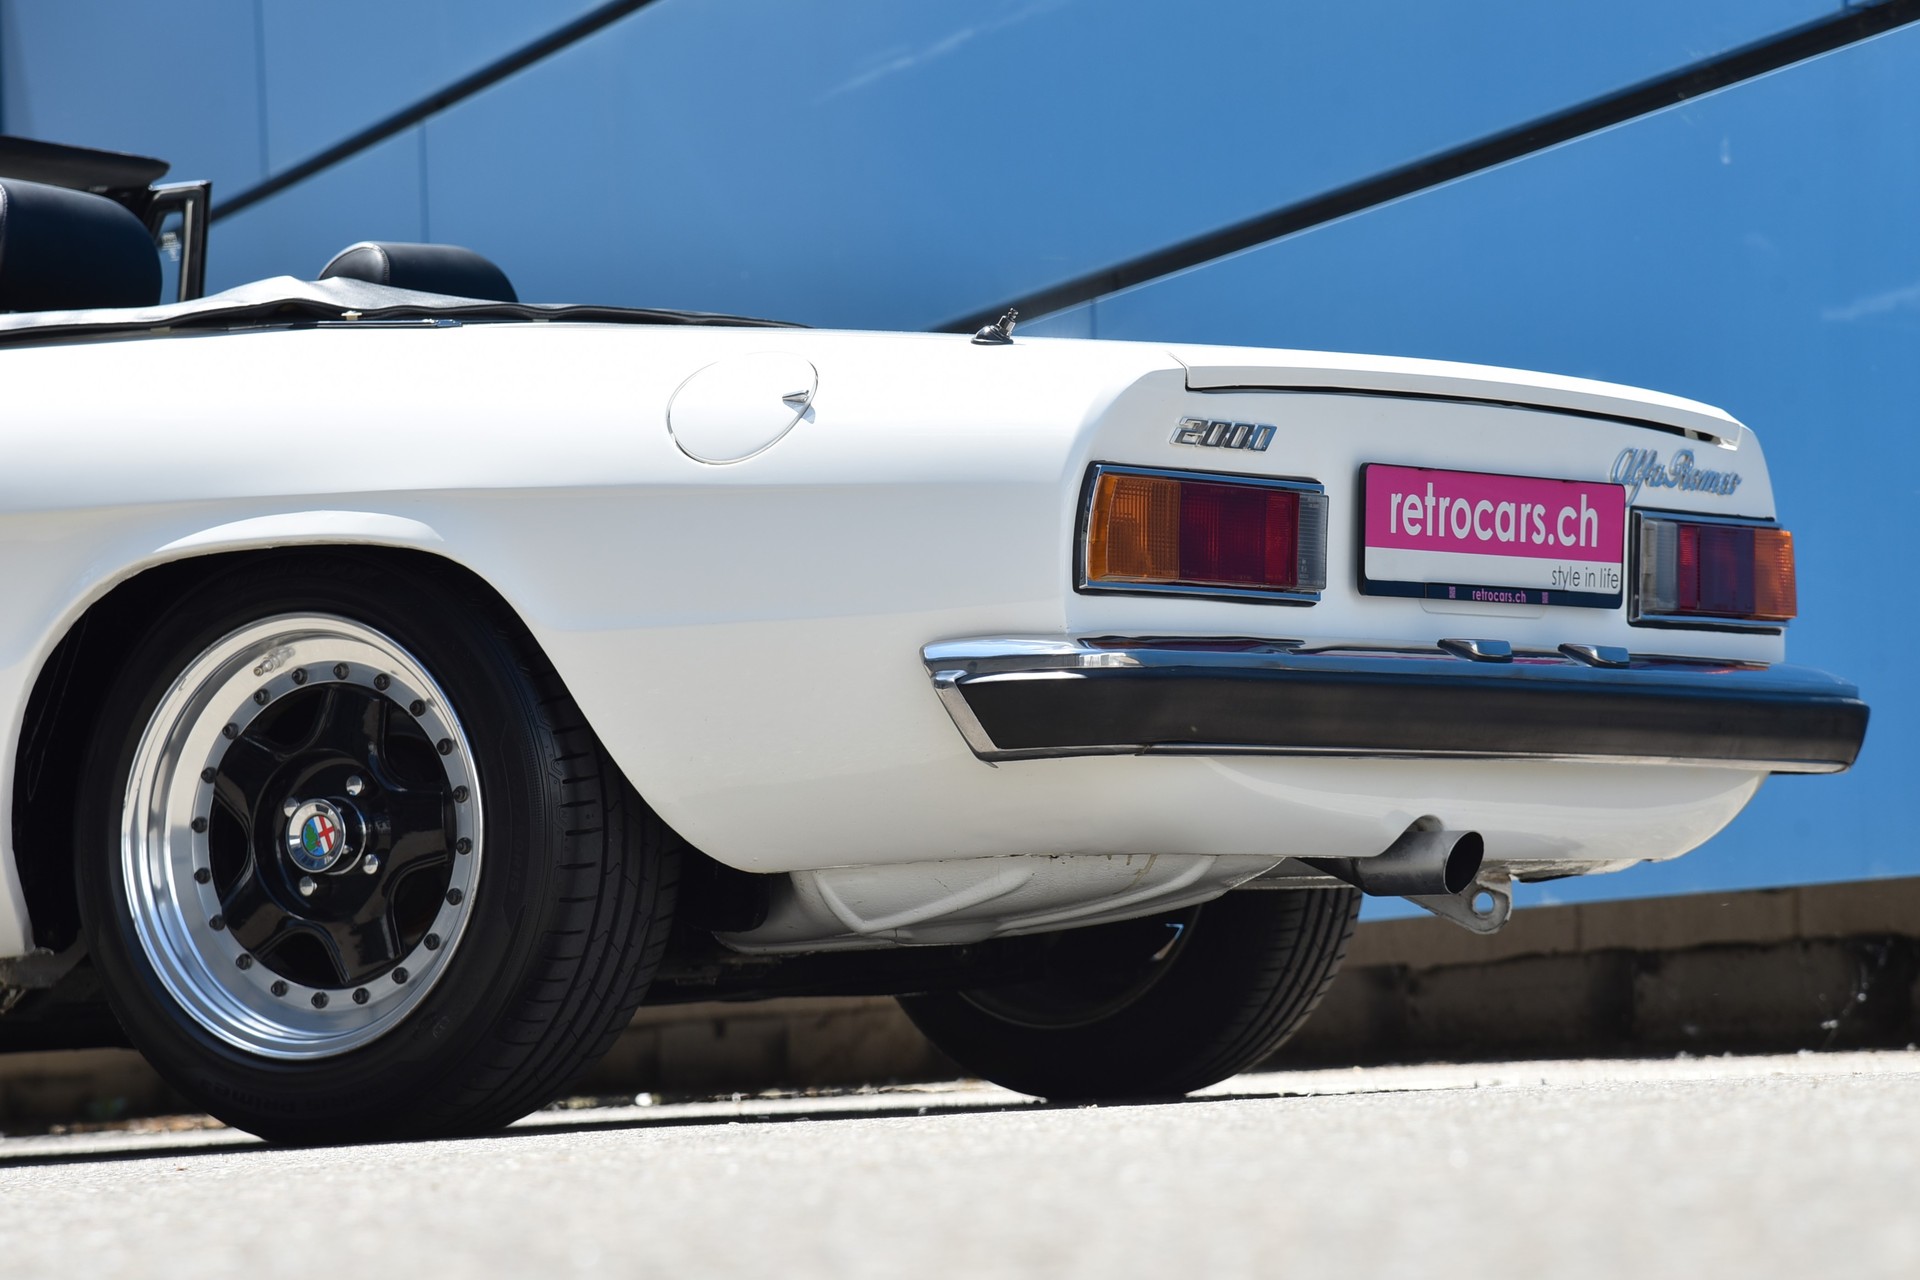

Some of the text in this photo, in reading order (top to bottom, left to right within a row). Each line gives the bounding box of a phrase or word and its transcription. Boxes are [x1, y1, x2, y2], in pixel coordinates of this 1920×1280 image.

[1169, 416, 1278, 452] 2000
[1609, 447, 1742, 507] Alfa Romeo
[1390, 482, 1598, 548] retrocars.ch
[1472, 588, 1527, 603] retrocars.ch
[1552, 565, 1620, 591] style in life
